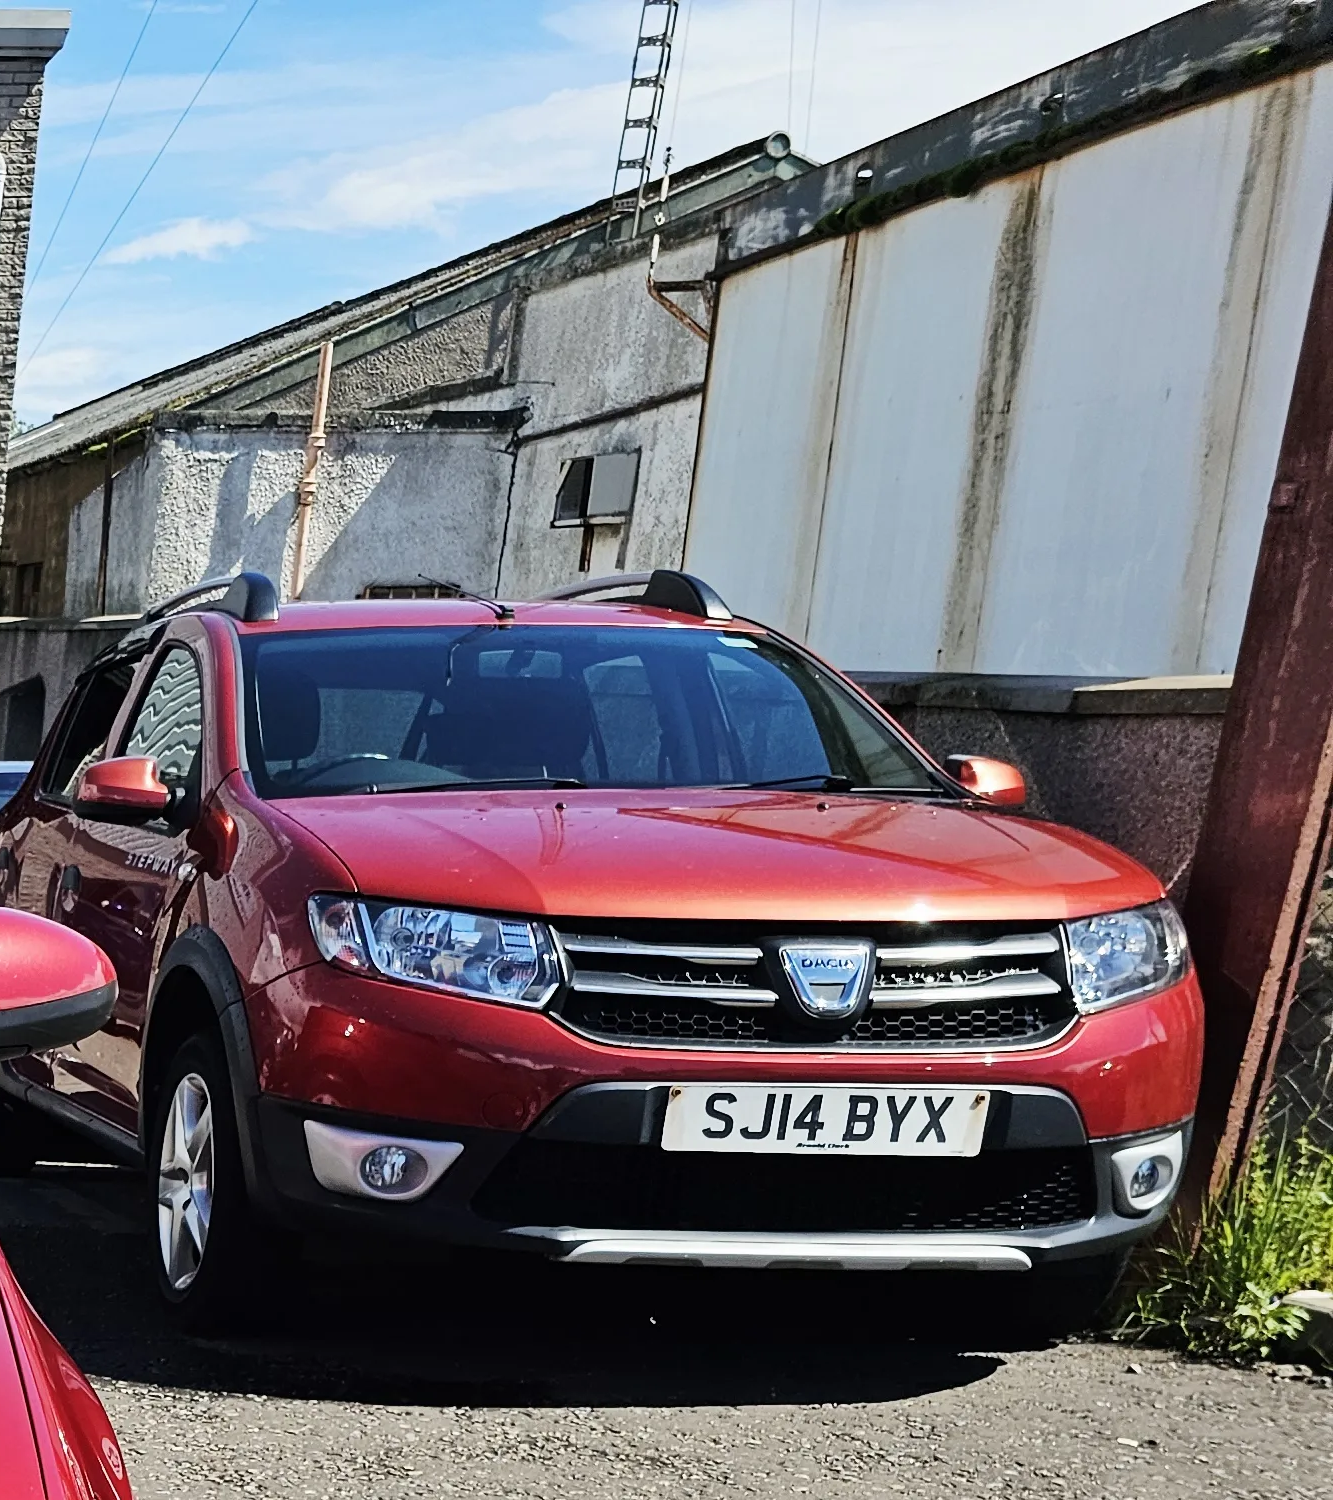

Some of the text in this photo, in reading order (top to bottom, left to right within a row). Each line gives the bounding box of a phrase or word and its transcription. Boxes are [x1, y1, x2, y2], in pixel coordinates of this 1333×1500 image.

[125, 853, 179, 875] STEPWAY
[801, 958, 855, 969] DACIA
[701, 1092, 955, 1143] SJ14 BYX
